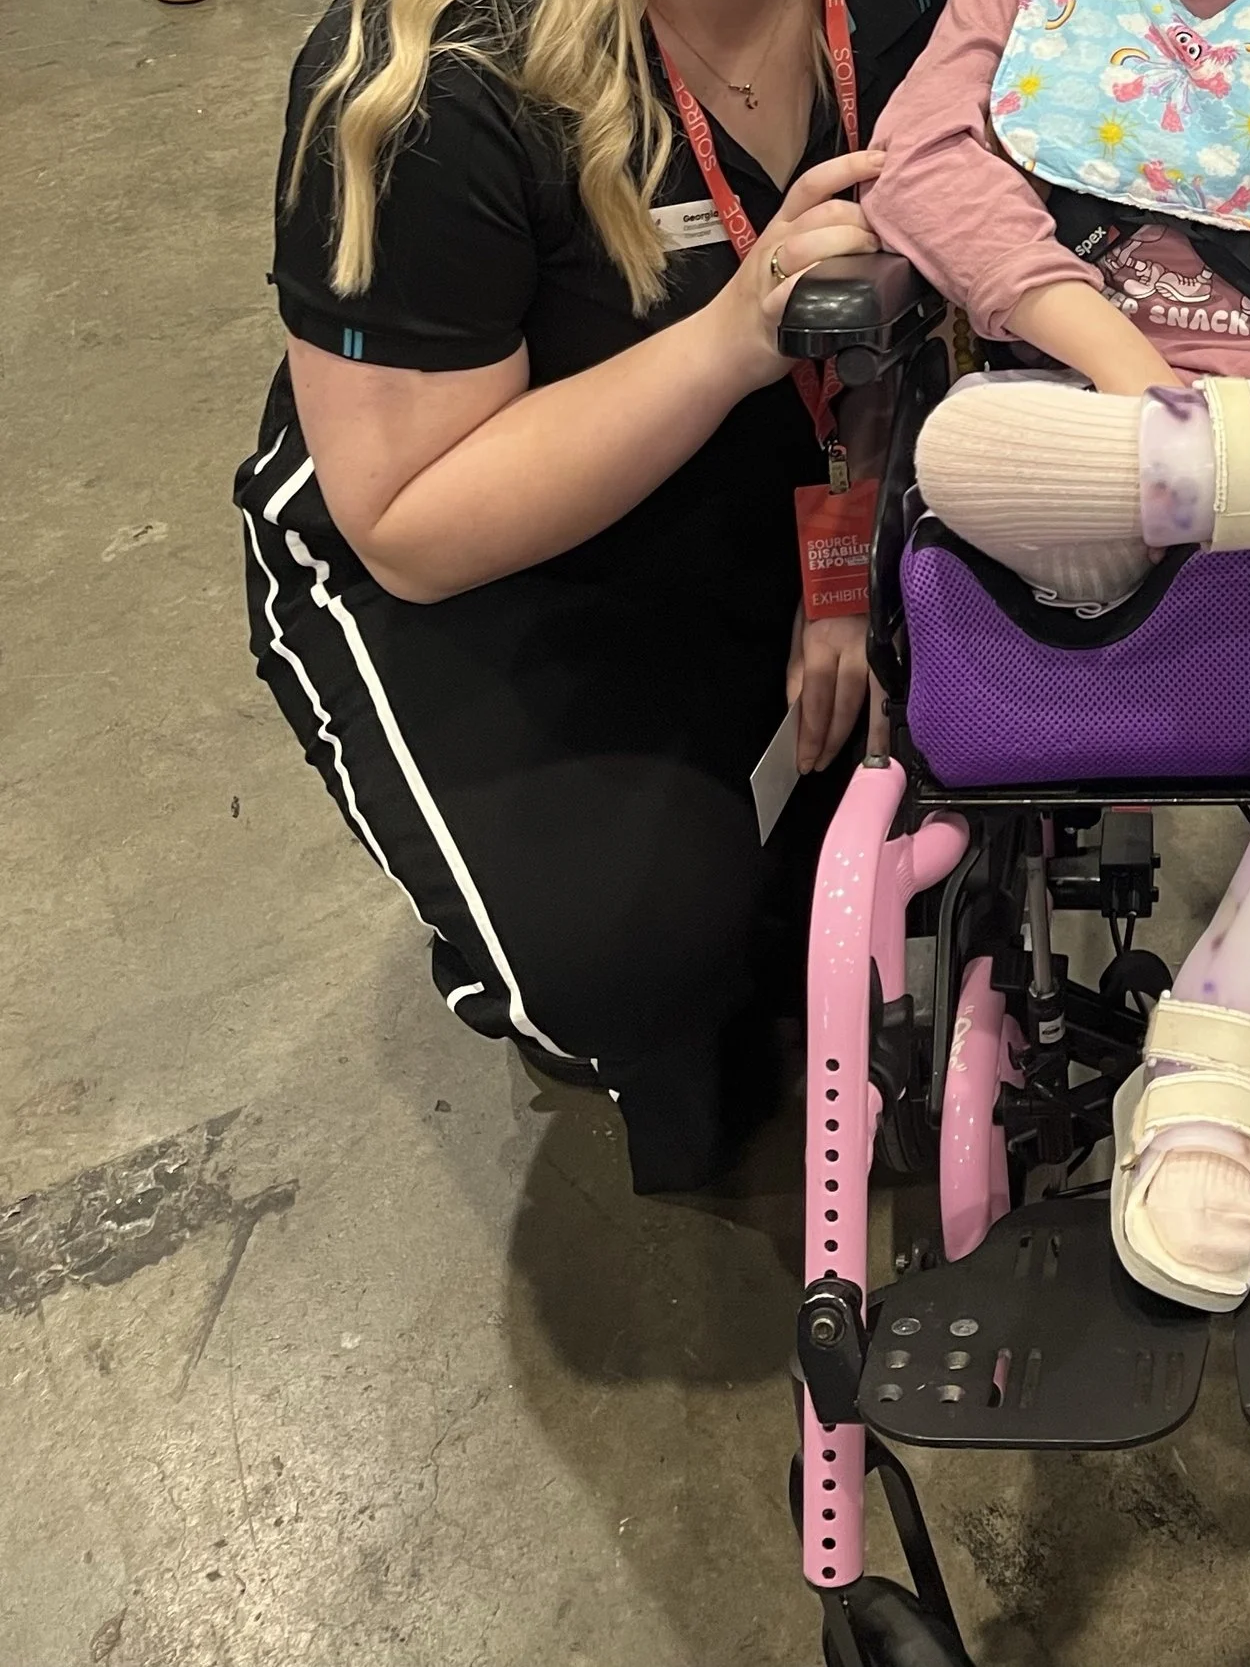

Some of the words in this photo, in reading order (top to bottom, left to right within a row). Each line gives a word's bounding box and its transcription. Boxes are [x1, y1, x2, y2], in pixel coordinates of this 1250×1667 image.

[676, 78, 717, 172] SOURCE
[723, 201, 757, 249] RCE
[1075, 225, 1107, 257] spex
[807, 534, 858, 550] SOURCE
[808, 543, 870, 560] DISABILIT
[809, 557, 844, 571] EXPO
[813, 587, 869, 606] EXHIBIT
